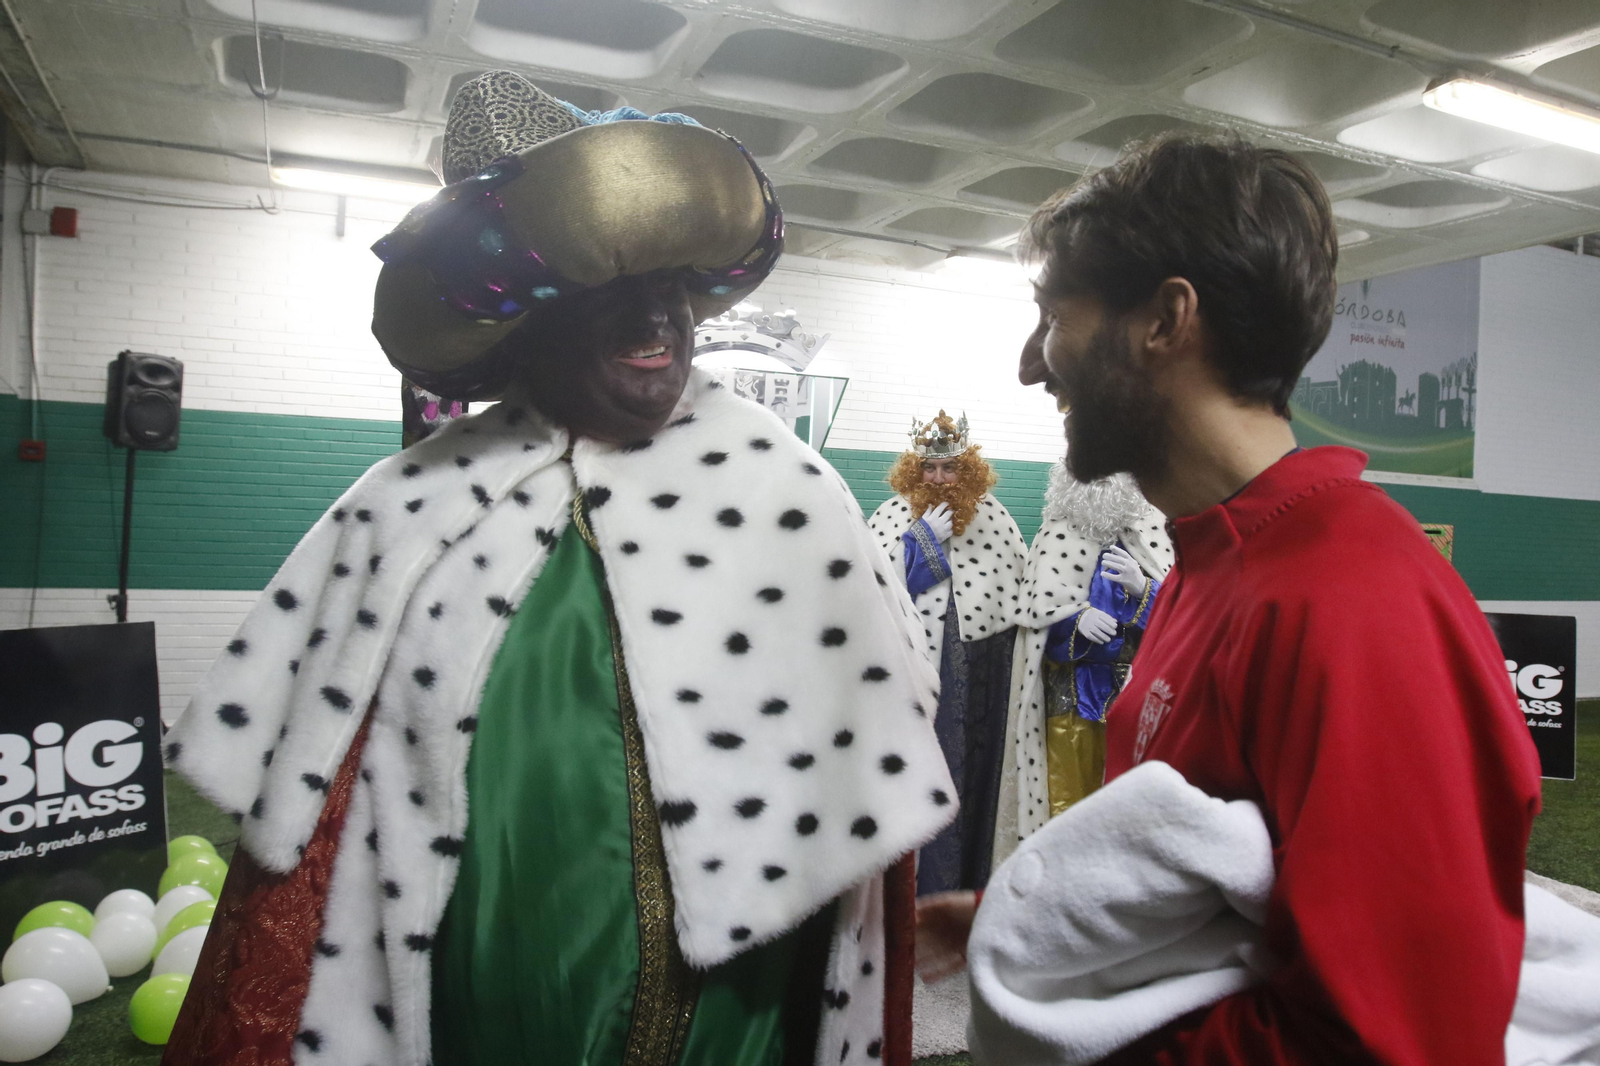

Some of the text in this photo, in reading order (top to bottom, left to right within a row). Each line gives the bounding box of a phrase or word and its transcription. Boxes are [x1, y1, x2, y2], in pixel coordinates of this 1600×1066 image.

[1350, 333, 1406, 349] pasión infinita
[1527, 718, 1562, 728] de sofass
[37, 831, 86, 857] grande
[88, 826, 105, 842] de
[107, 819, 148, 838] sofass
